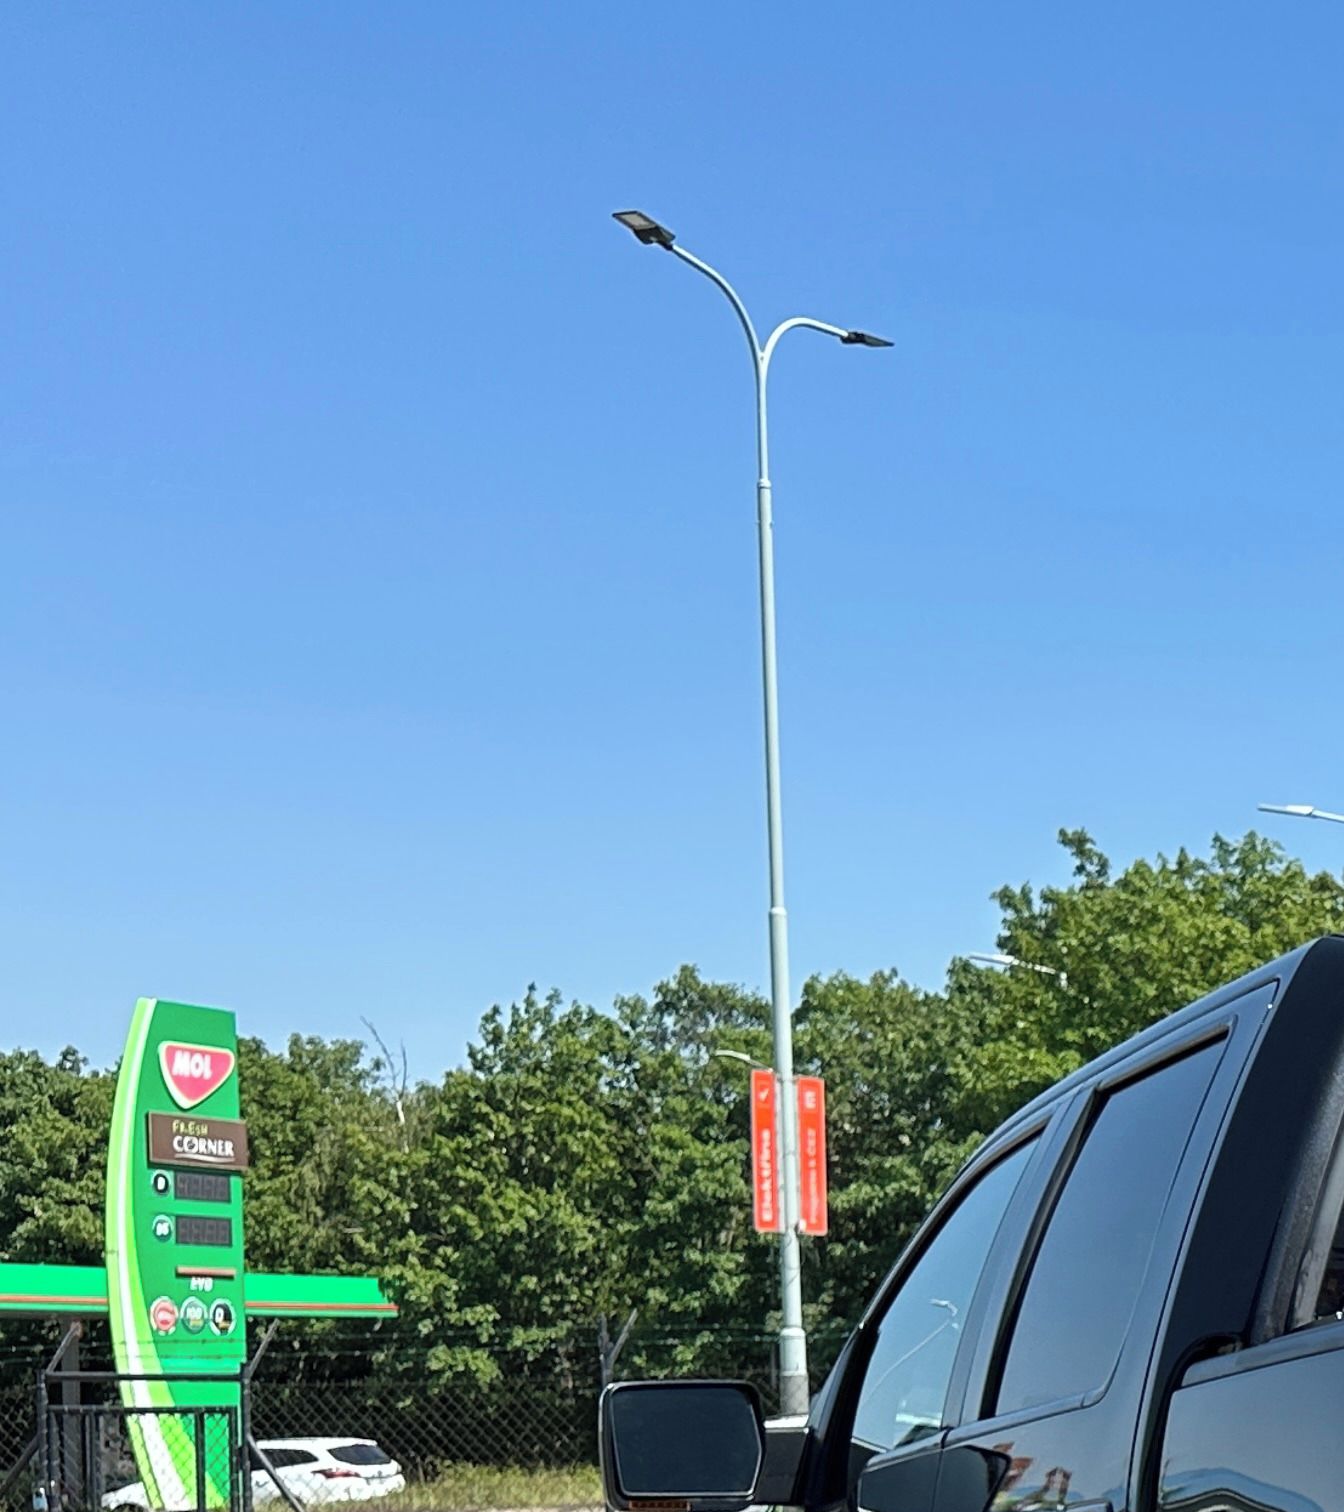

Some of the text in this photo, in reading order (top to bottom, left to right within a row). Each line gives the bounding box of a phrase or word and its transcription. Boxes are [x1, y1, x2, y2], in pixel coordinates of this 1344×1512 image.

[171, 1050, 213, 1080] MOL
[172, 1119, 209, 1137] FRESH
[172, 1135, 235, 1157] CORNER
